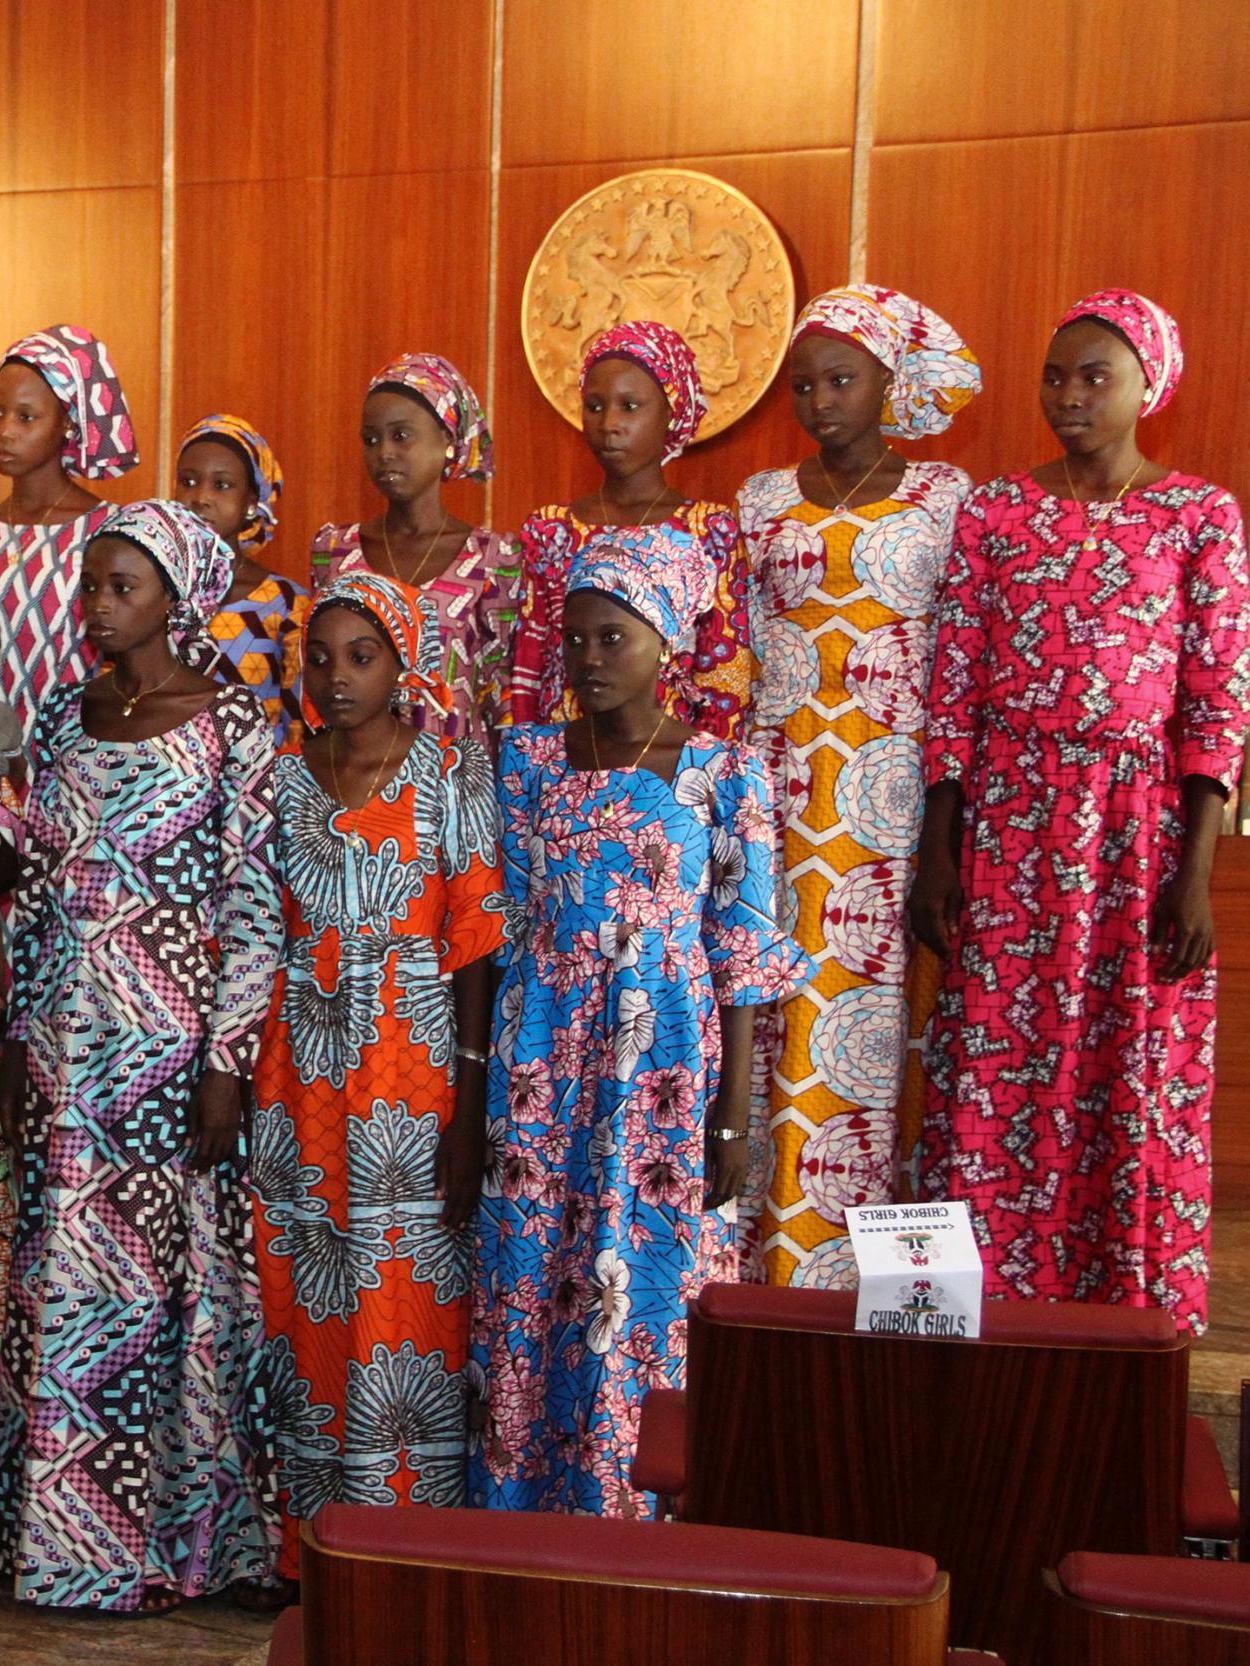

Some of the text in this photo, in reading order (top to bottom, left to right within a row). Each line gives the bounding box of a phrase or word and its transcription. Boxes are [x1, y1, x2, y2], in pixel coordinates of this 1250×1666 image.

[859, 1207, 948, 1221] CHIBOK GIRLS
[869, 1310, 966, 1337] CHIBOK GIRLS
